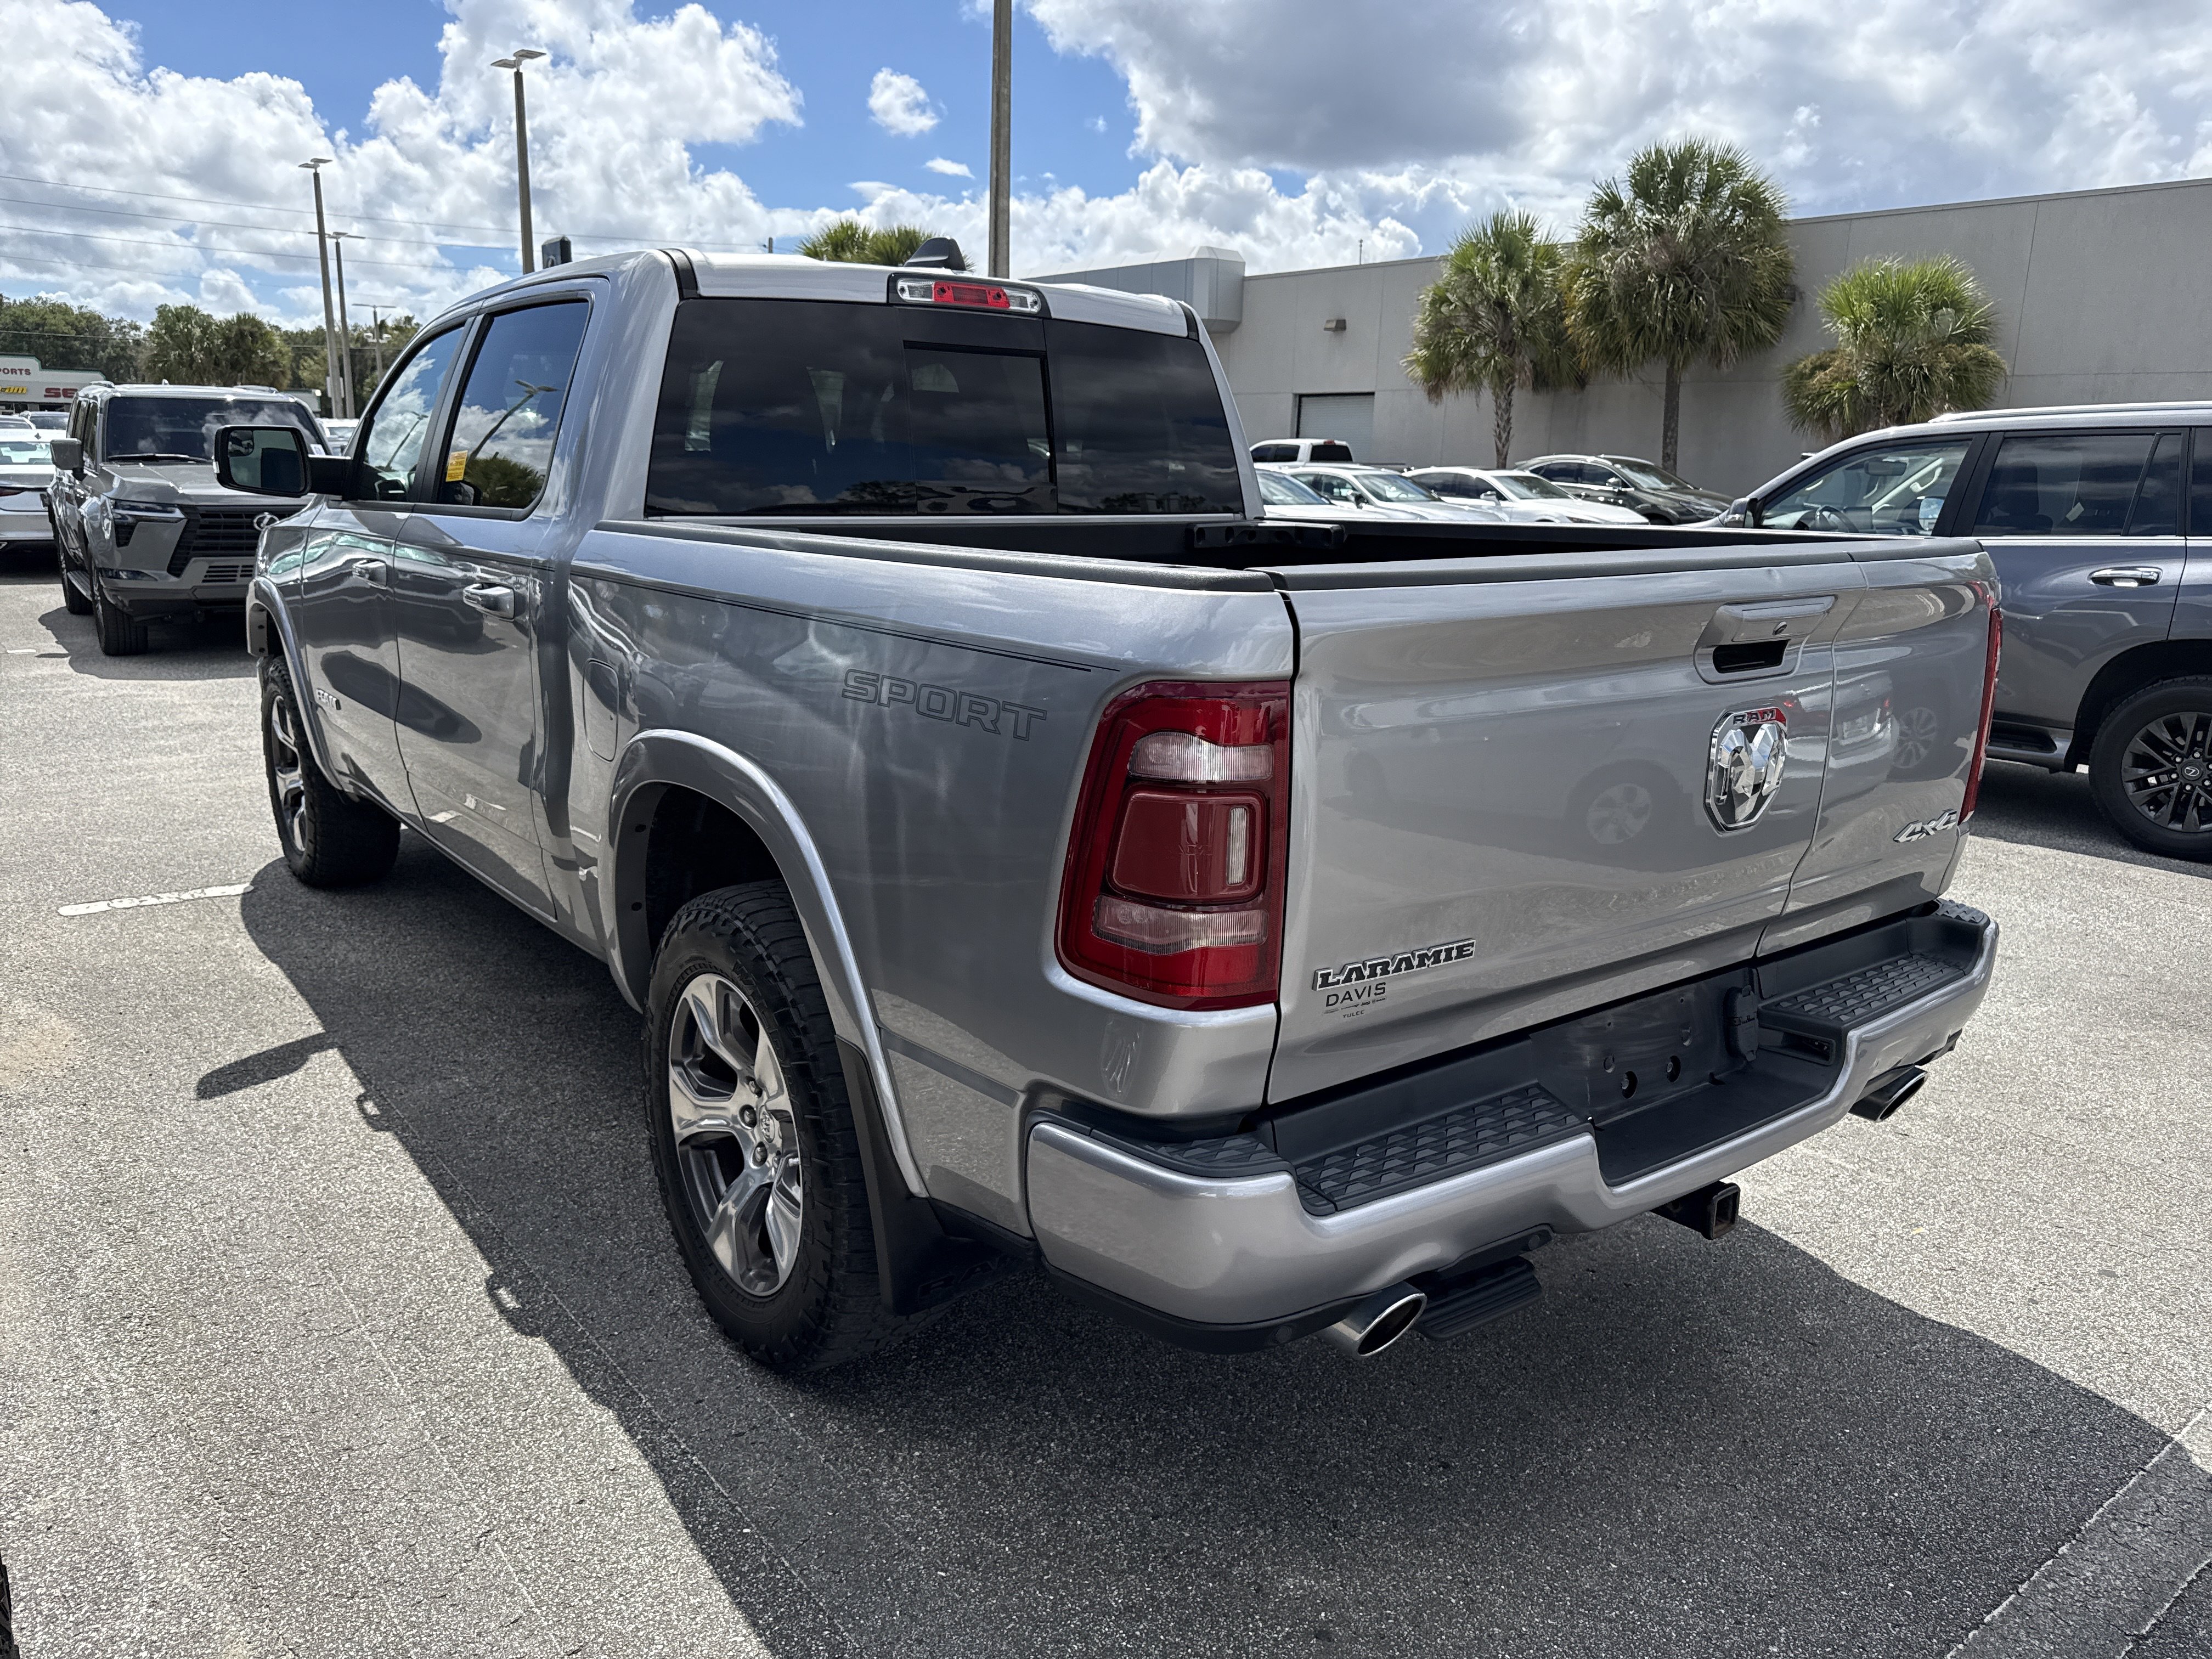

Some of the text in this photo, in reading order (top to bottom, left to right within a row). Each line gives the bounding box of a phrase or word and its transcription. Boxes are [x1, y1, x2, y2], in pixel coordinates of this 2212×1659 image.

[842, 669, 1047, 742] SPORT
[1733, 709, 1776, 724] RAM
[1312, 938, 1476, 991] LARAMIE
[1325, 981, 1386, 1007] DAVIS
[1342, 1009, 1365, 1019] YULEE
